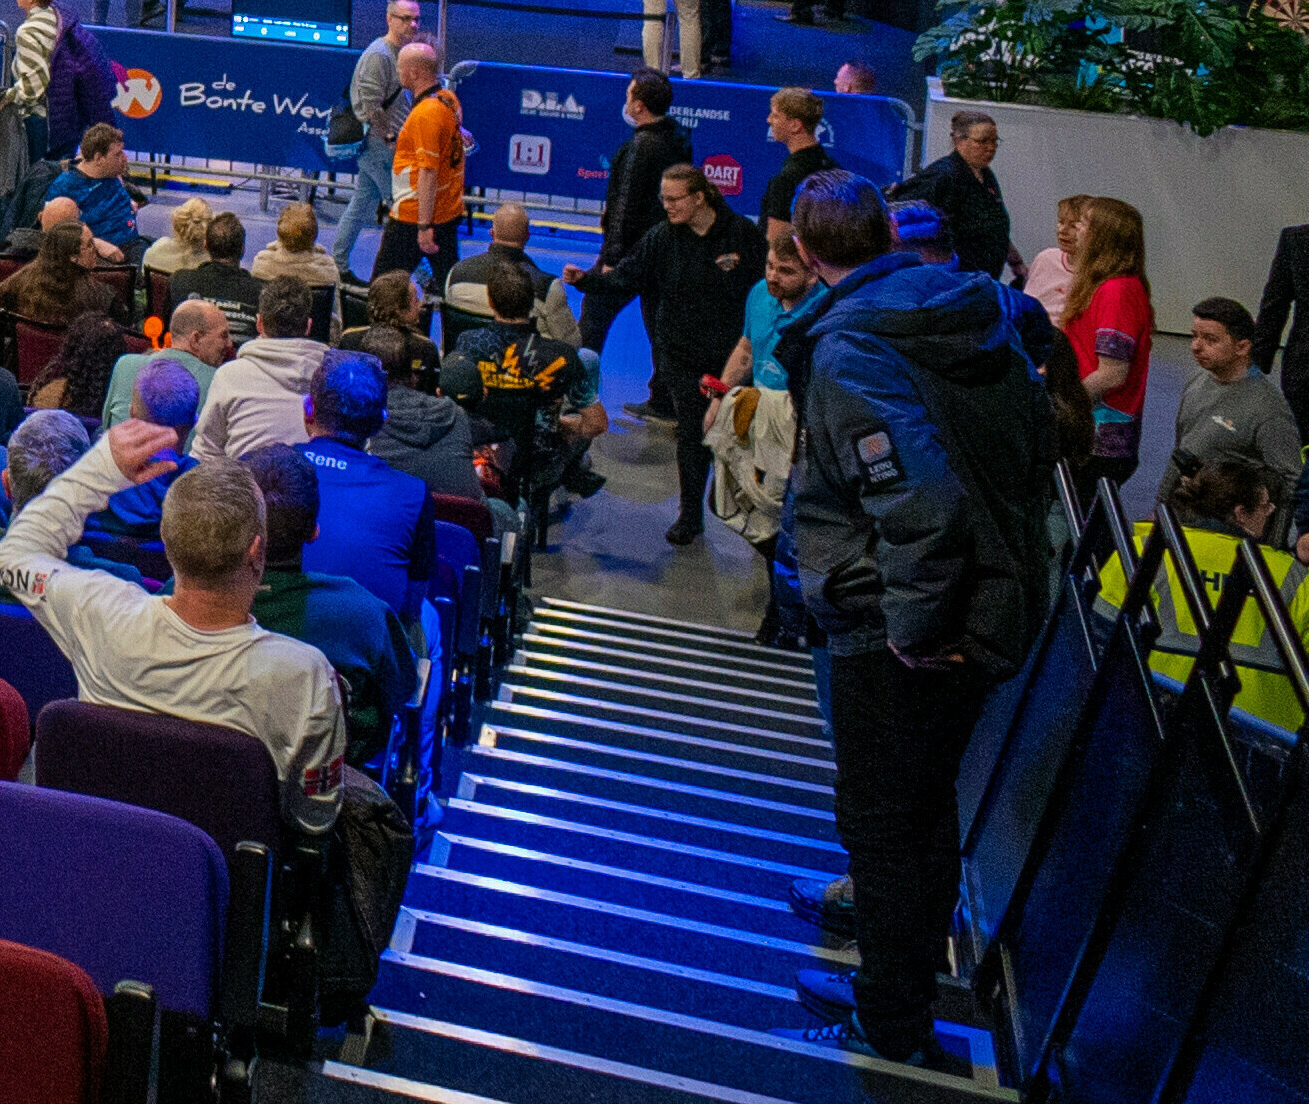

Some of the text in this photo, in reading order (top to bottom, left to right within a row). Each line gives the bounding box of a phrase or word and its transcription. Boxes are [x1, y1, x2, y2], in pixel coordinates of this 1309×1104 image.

[212, 73, 236, 91] de
[179, 83, 333, 119] Bonte Wev
[669, 106, 731, 121] DERLANDSE
[704, 164, 740, 181] DART
